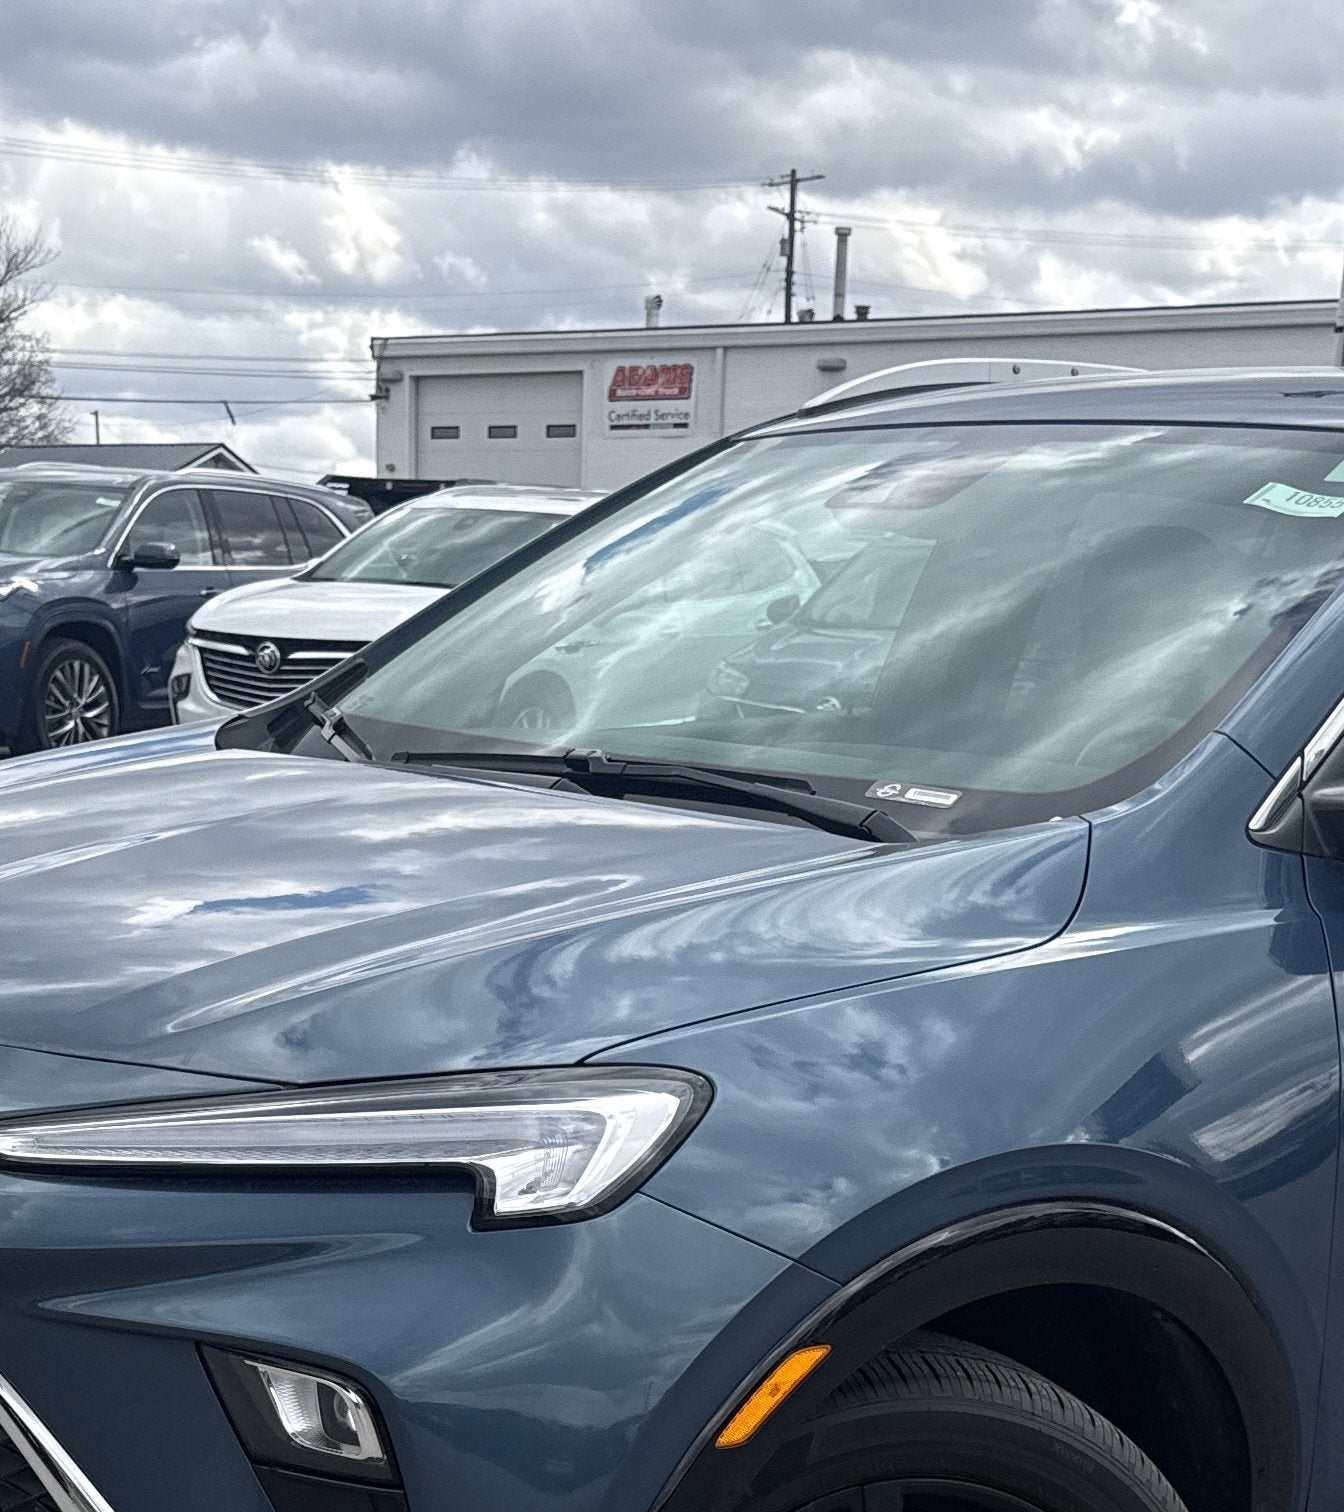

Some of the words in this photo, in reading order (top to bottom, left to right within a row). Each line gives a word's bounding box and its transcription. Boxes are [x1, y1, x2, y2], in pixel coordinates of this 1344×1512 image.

[611, 365, 692, 387] ADAMS
[608, 409, 651, 422] Certified
[654, 409, 690, 421] Service
